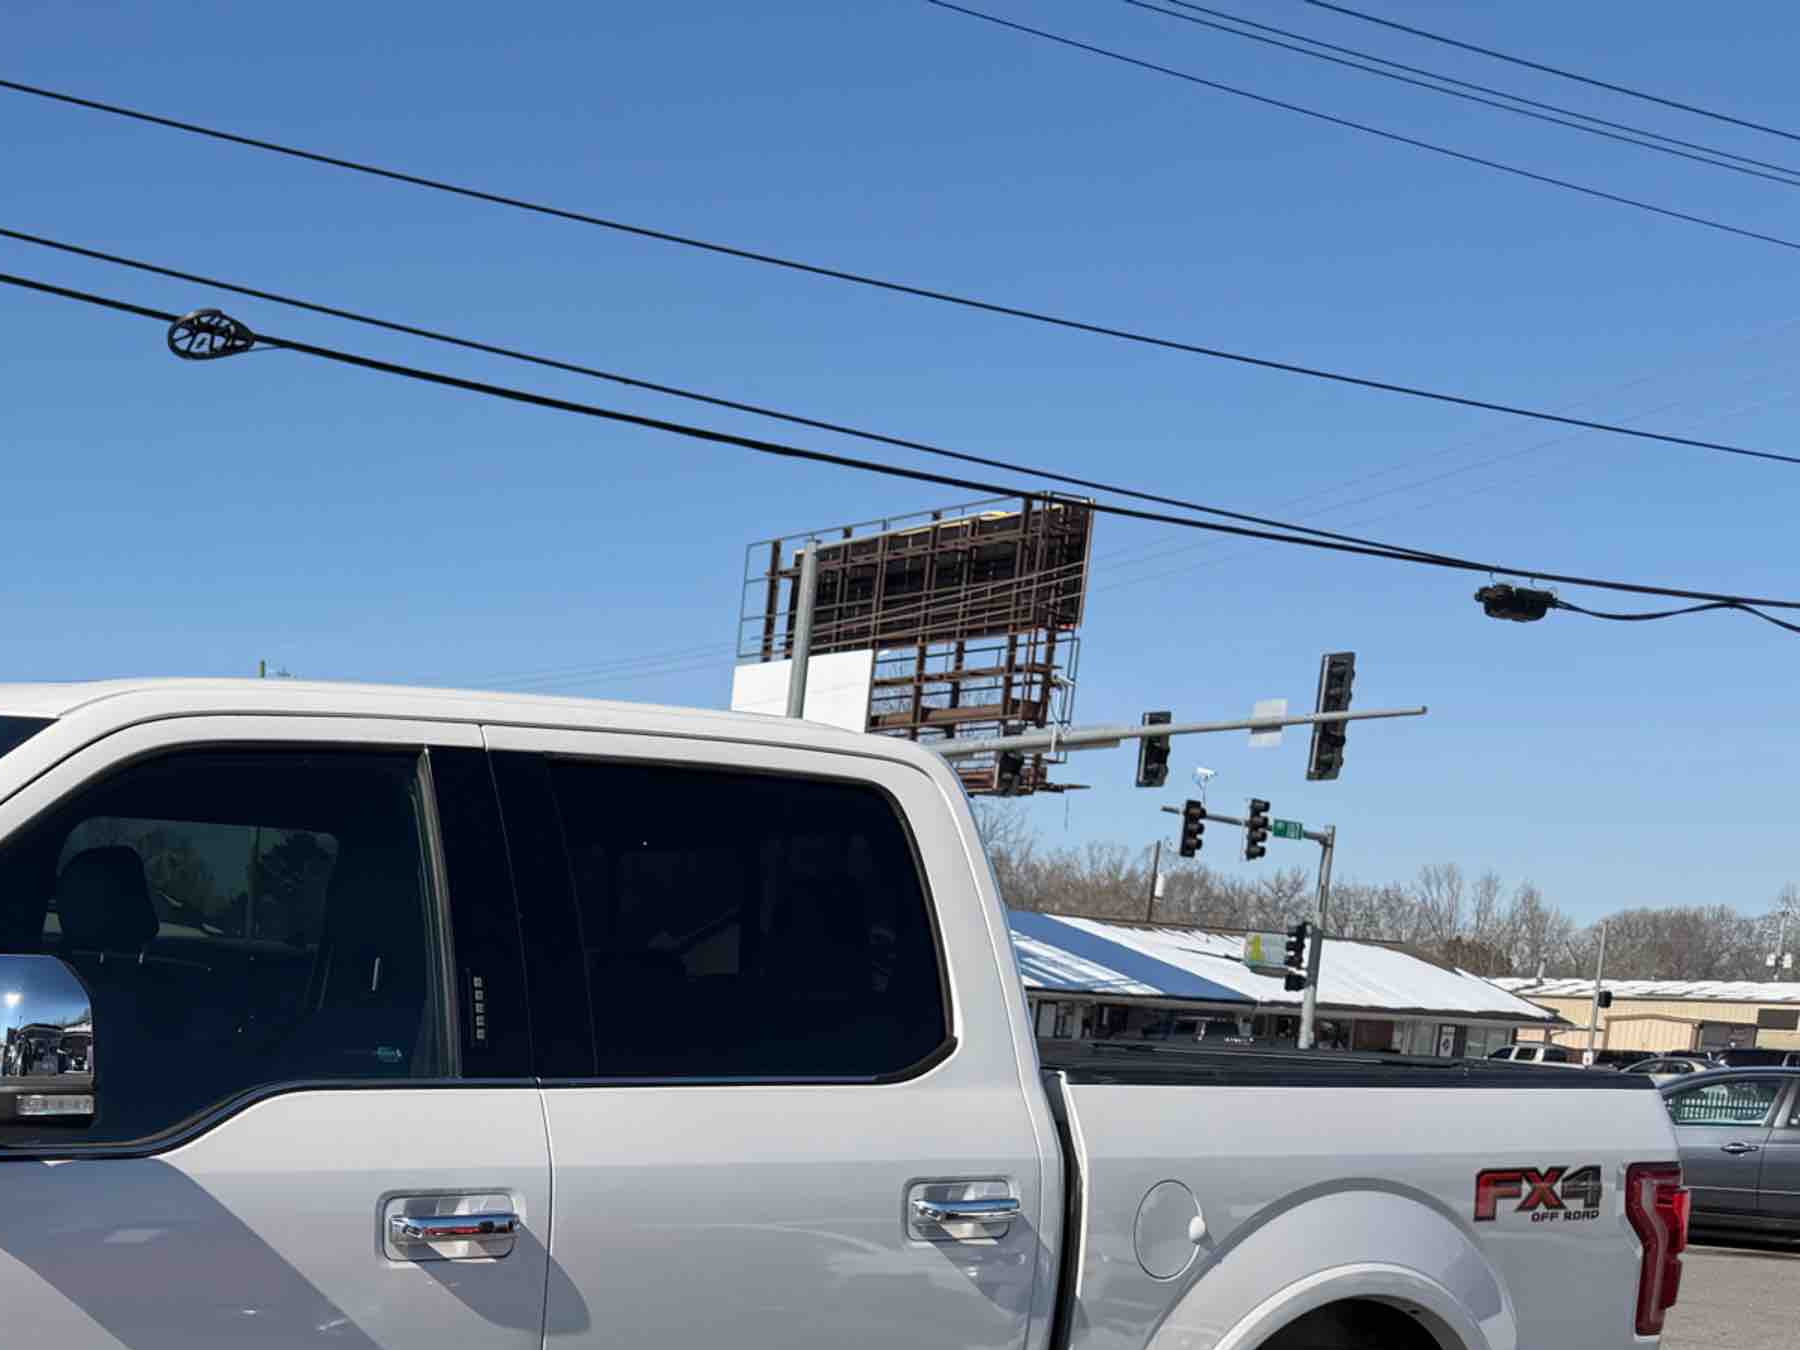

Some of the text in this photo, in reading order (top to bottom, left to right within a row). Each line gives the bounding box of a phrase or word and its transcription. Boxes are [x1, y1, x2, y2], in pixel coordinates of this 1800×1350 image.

[1473, 1166, 1602, 1222] FX4
[1531, 1210, 1600, 1223] OFF ROAD
